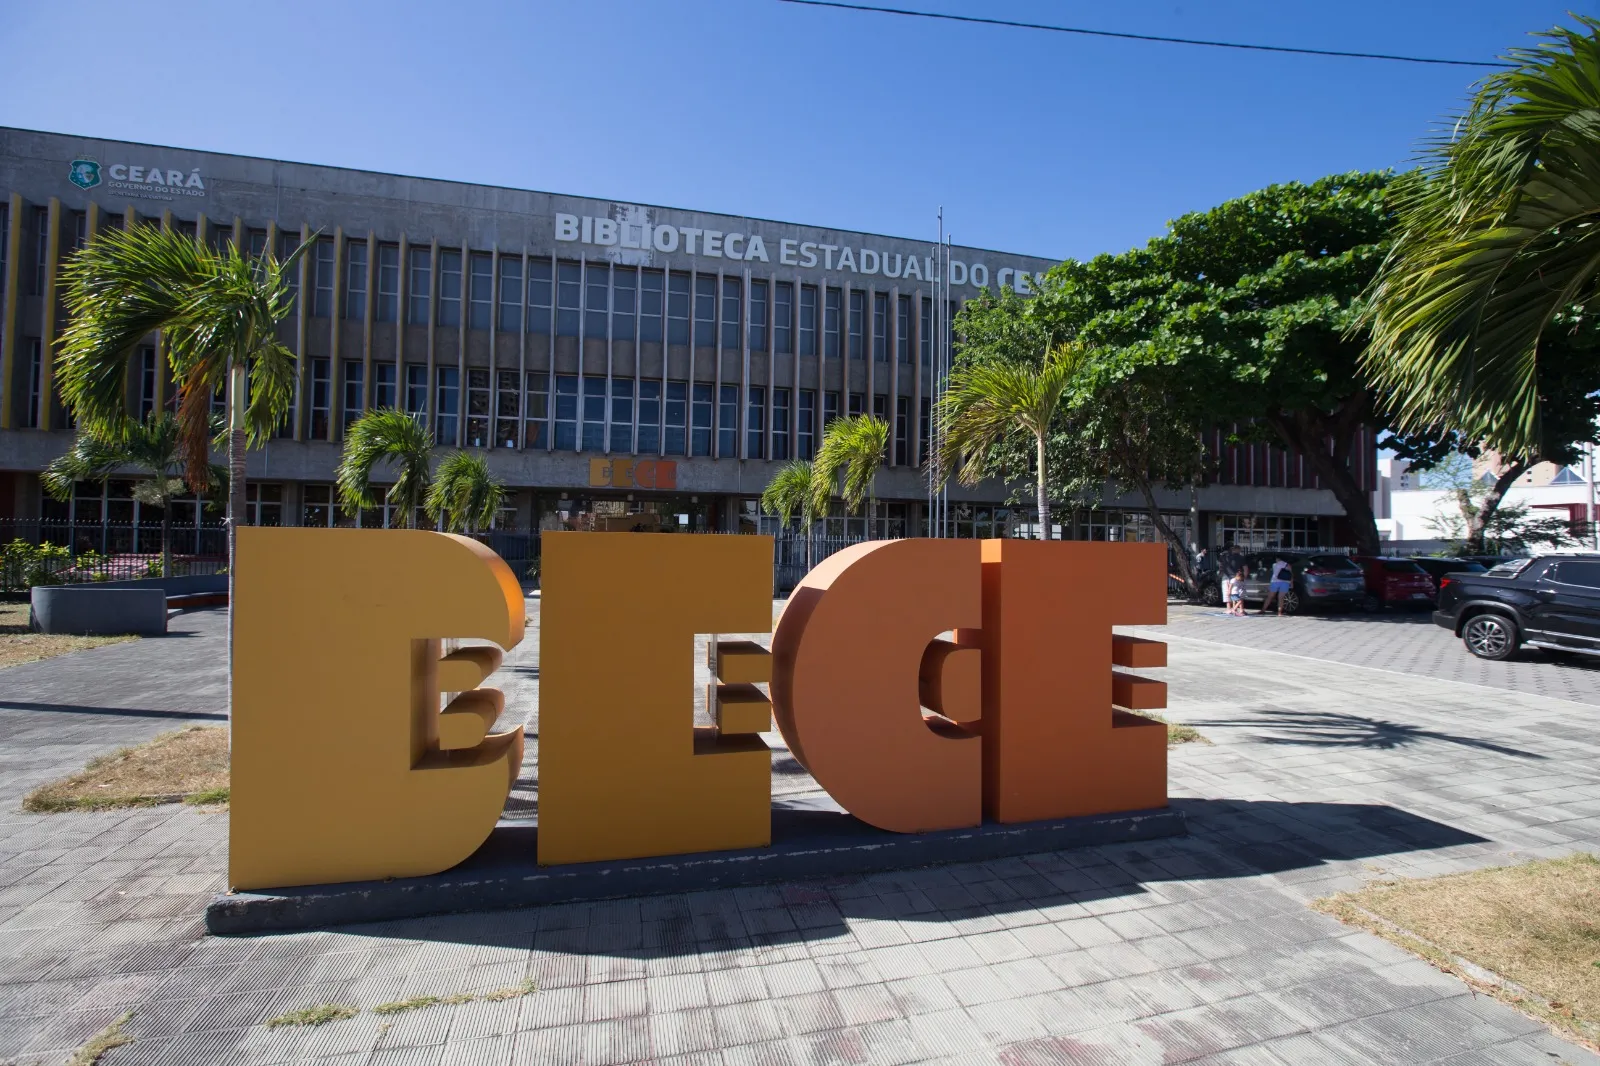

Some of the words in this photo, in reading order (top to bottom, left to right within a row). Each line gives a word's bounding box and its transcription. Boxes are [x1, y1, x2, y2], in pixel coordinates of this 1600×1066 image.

[108, 181, 153, 192] GOVERNO
[155, 186, 169, 194] DO
[170, 187, 205, 197] ESTADO
[109, 164, 205, 190] CEARÁ
[555, 212, 769, 263] BIBLIOTECA
[780, 238, 940, 283] ESTADUAL
[950, 260, 989, 289] DO
[589, 457, 677, 489] BECE
[228, 525, 1168, 891] BECE
